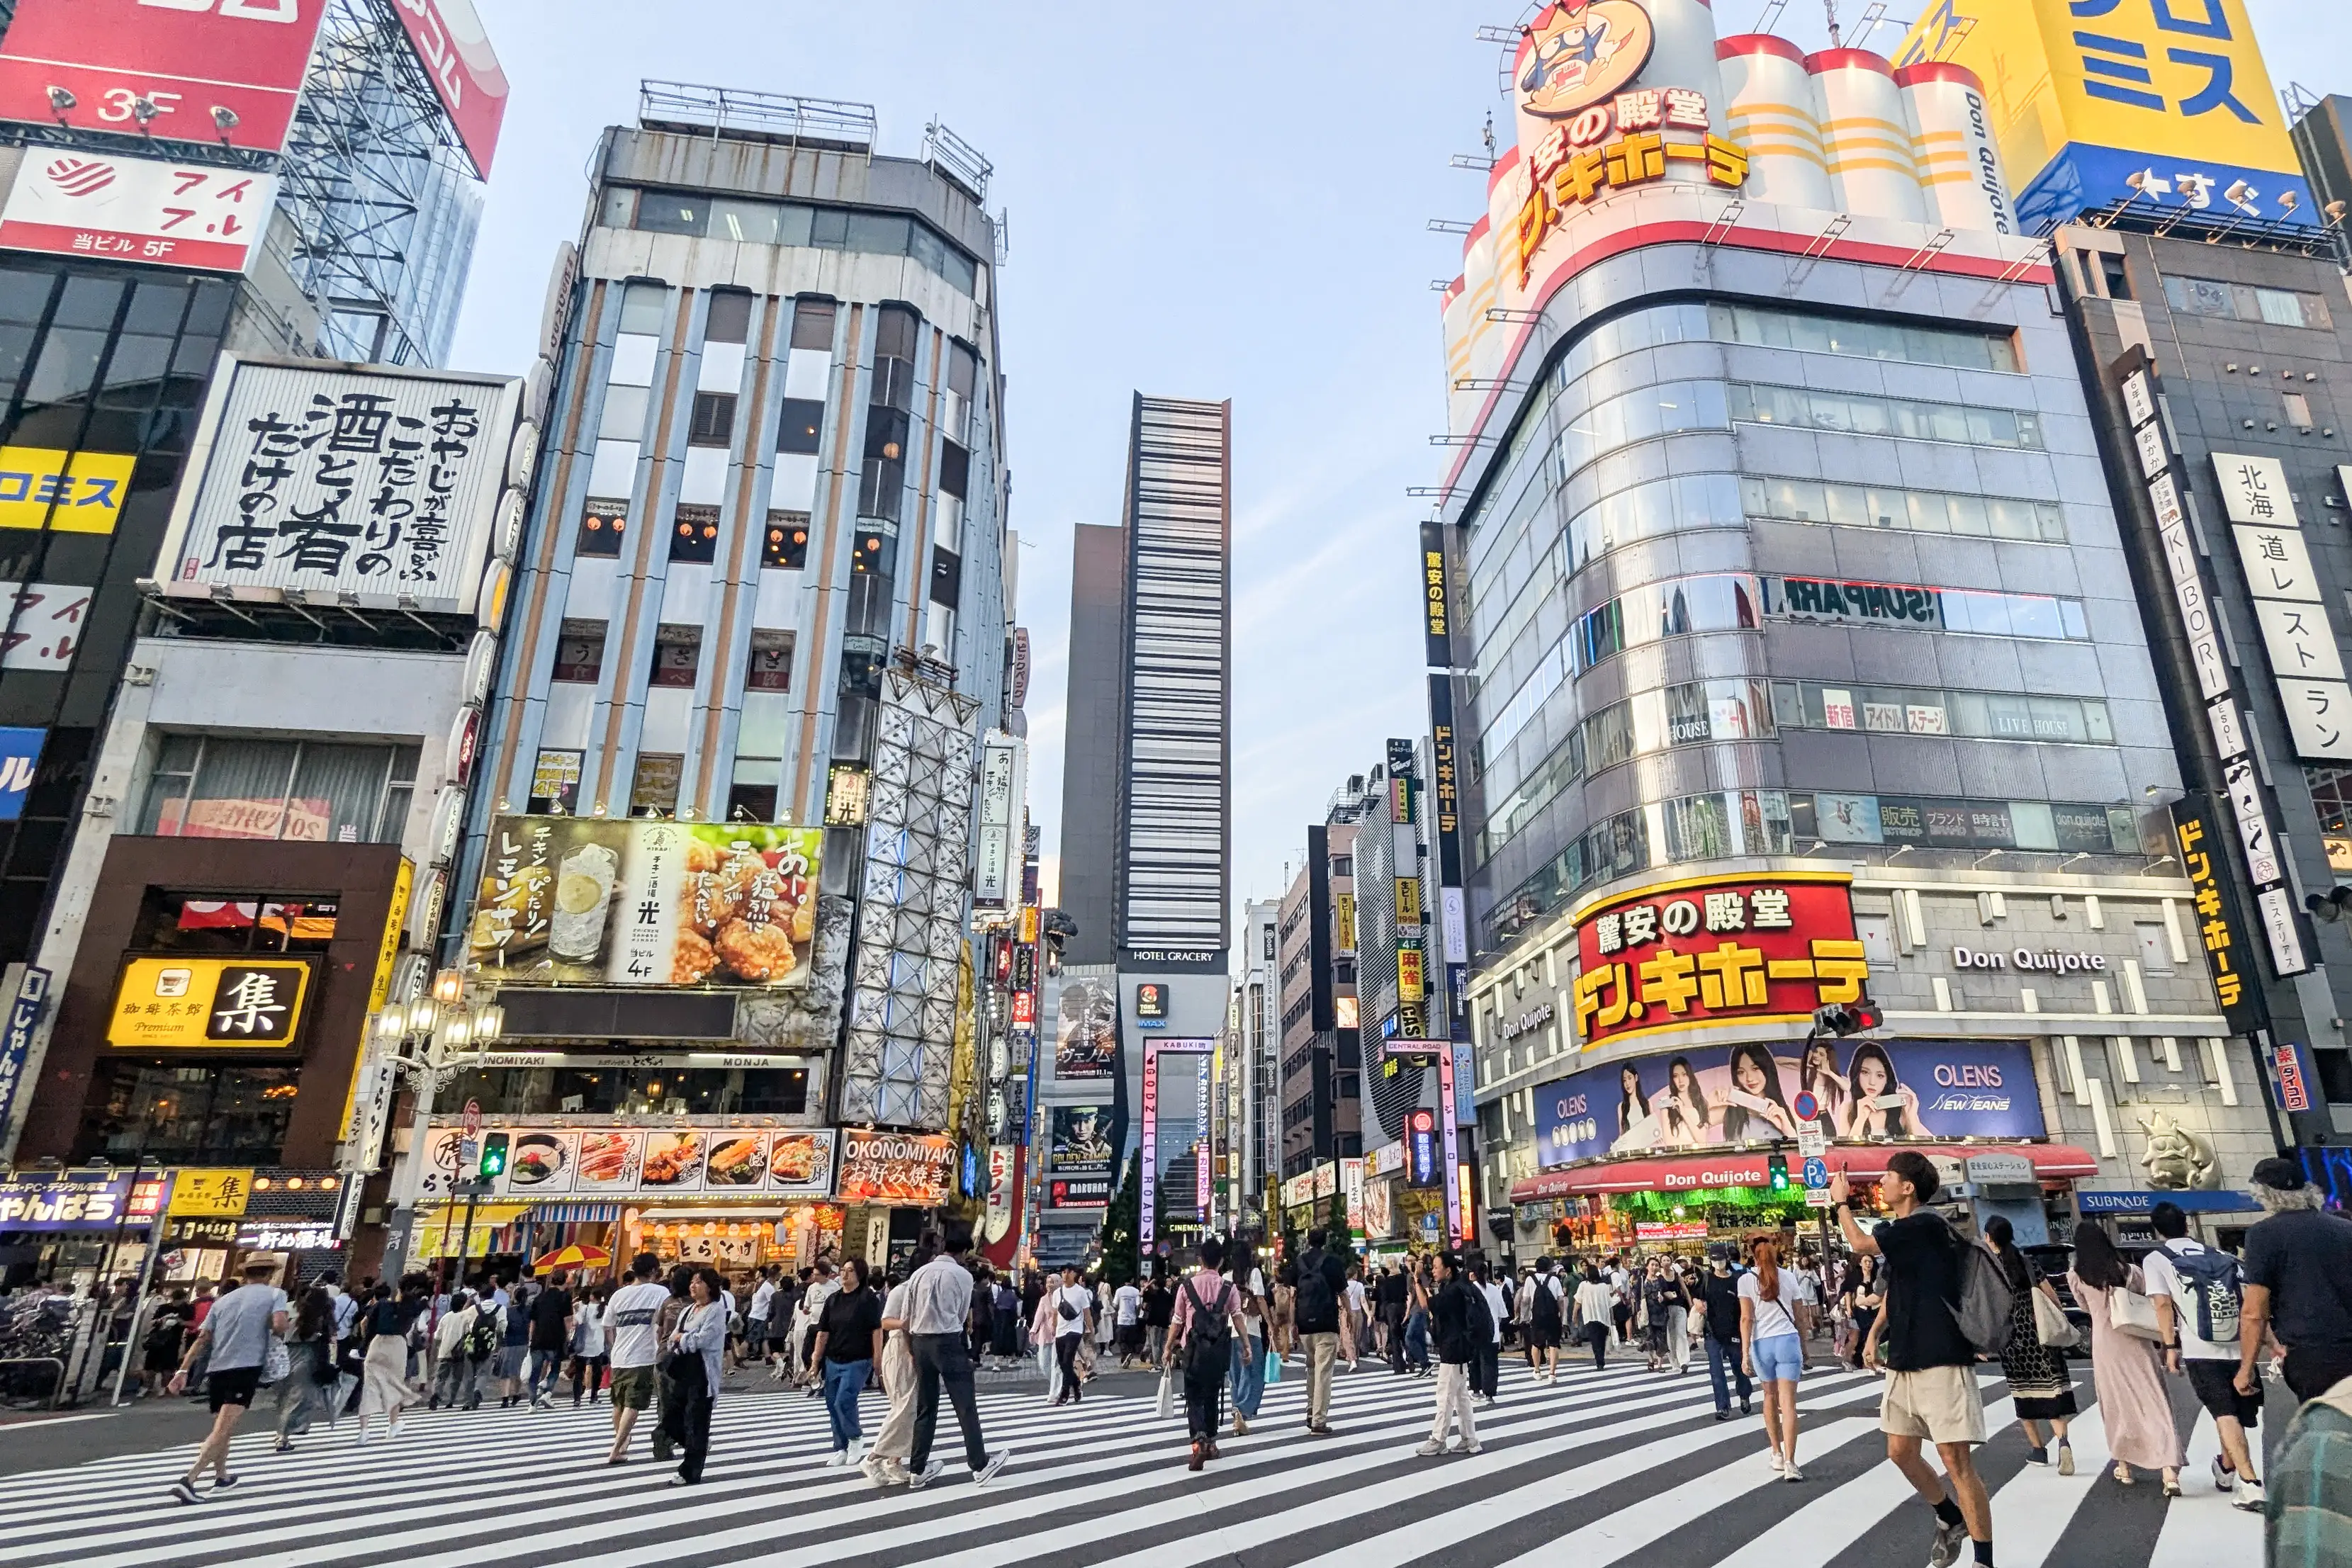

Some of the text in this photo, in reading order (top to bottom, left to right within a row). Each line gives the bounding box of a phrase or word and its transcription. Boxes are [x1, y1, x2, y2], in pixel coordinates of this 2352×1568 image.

[2073, 32, 2263, 125] ミス
[98, 88, 182, 125] 3F
[1965, 91, 2008, 236] Don Quijote
[173, 171, 254, 203] アイ
[160, 207, 243, 235] フル
[72, 234, 176, 257] 当ビル 5F
[2130, 380, 2146, 419] 6年4組
[203, 412, 308, 572] だけの店
[356, 417, 427, 575] こだわりの
[10, 592, 89, 621] アイ
[1427, 551, 1446, 635] 驚安の殿堂
[2239, 464, 2341, 749] 北海道レストラン
[2168, 533, 2215, 688] KIBORI
[1825, 704, 1855, 728] 新宿
[1865, 705, 1902, 730] アイドル
[1908, 709, 1944, 731] ステージ
[1998, 716, 2069, 735] LIVE HOUSE
[2218, 704, 2237, 754] ESOLA
[533, 780, 562, 798] 4F
[1881, 806, 1920, 828] 販売
[1927, 813, 1964, 826] ブランド
[1972, 813, 2008, 828] 時計
[491, 831, 522, 969] レモンサワー
[638, 901, 660, 925] 光
[1597, 889, 1792, 954] 驚安の殿堂
[2268, 894, 2295, 969] ミステリアス
[1134, 951, 1214, 961] HOTEL GRACERY
[1402, 940, 1418, 949] 4F
[628, 959, 653, 978] 4F
[1402, 952, 1420, 986] 麻雀
[1954, 946, 2106, 975] Don Quijote
[216, 972, 286, 1033] 集
[134, 1022, 185, 1032] Premium
[1504, 1003, 1551, 1040] Don Quijote
[723, 1058, 770, 1066] MONJA
[1933, 1064, 2003, 1088] OLENS
[1557, 1093, 1587, 1119] OLENS
[845, 1140, 957, 1166] OKONOMIYAKI
[1142, 1068, 1156, 1224] GODZILLA ROAD
[848, 1161, 945, 1190] お好み焼き
[989, 1150, 1005, 1207] トラノコ
[1070, 1183, 1108, 1194] MARUHAN
[1665, 1170, 1762, 1187] Don Quijote
[1807, 1165, 1818, 1185] P
[213, 1176, 244, 1208] 集
[2086, 1195, 2149, 1207] SUBNADE
[237, 1230, 334, 1250] 一軒め酒場
[1170, 1224, 1203, 1232] CINEMAS
[2207, 1285, 2223, 1318] FACE
